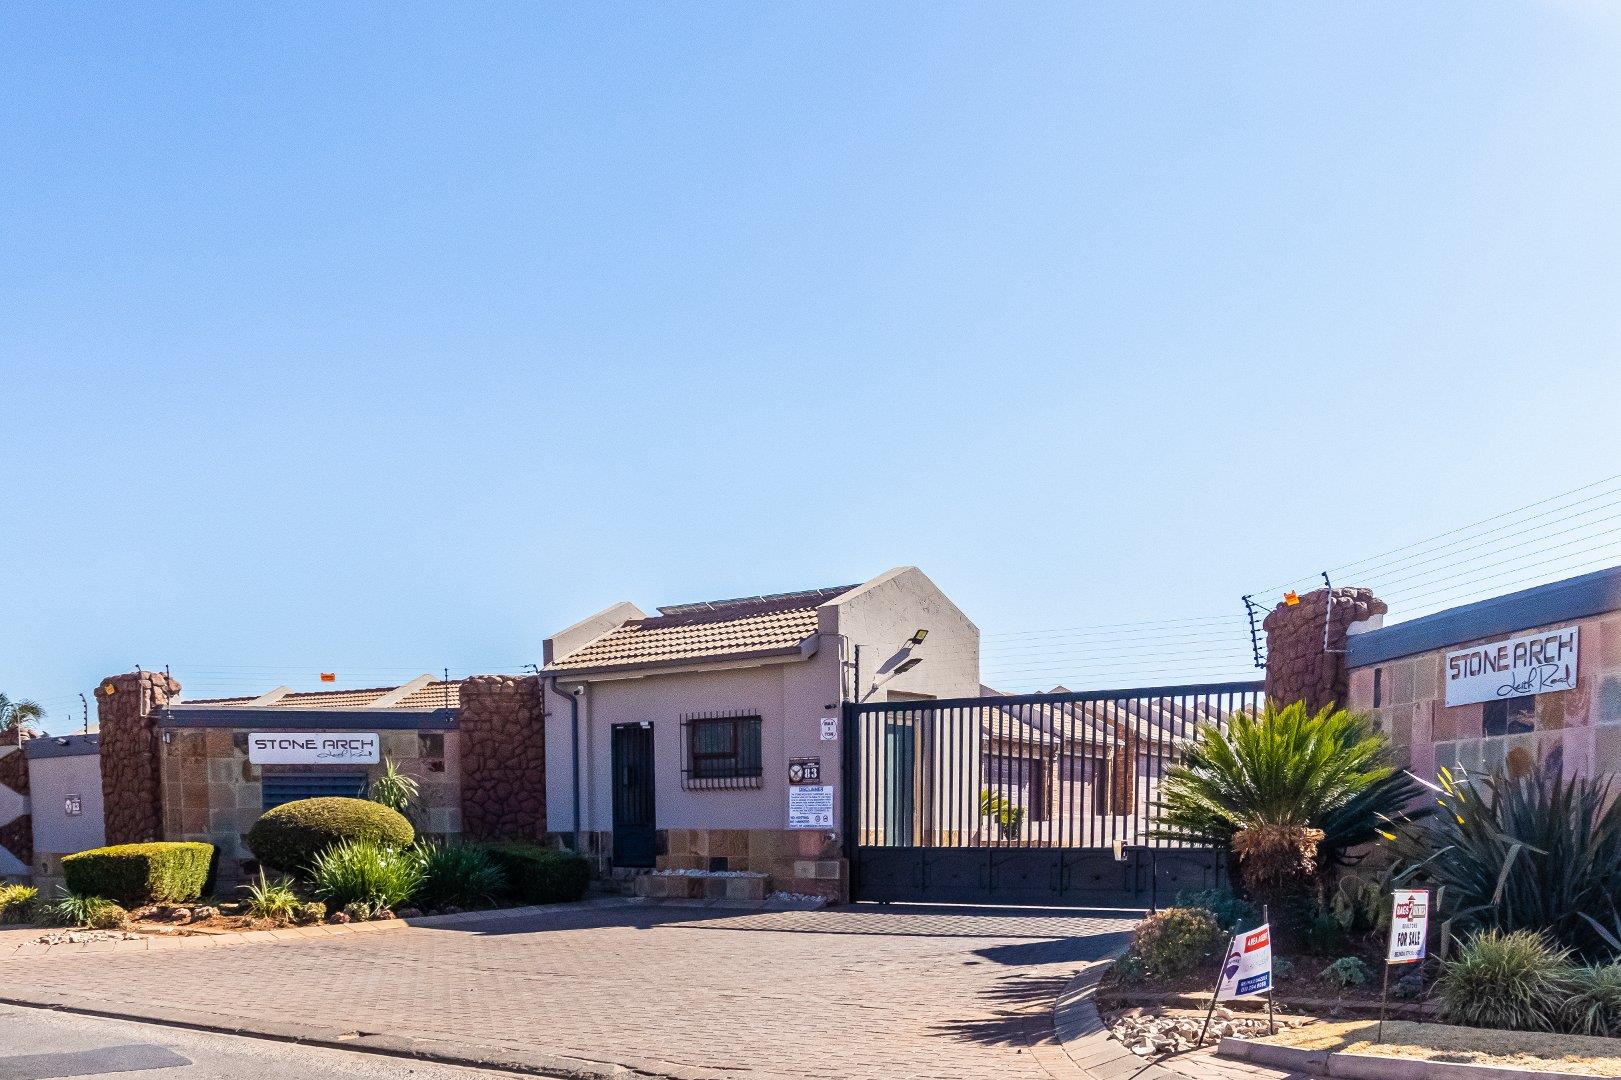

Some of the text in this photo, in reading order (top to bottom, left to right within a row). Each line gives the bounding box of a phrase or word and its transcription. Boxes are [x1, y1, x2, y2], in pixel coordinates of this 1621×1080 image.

[1449, 632, 1574, 681] STONE ARCH
[1497, 663, 1573, 697] Leith Road
[255, 739, 374, 750] STONE ARCH
[804, 767, 818, 779] 83
[1397, 930, 1421, 948] FOR SALE
